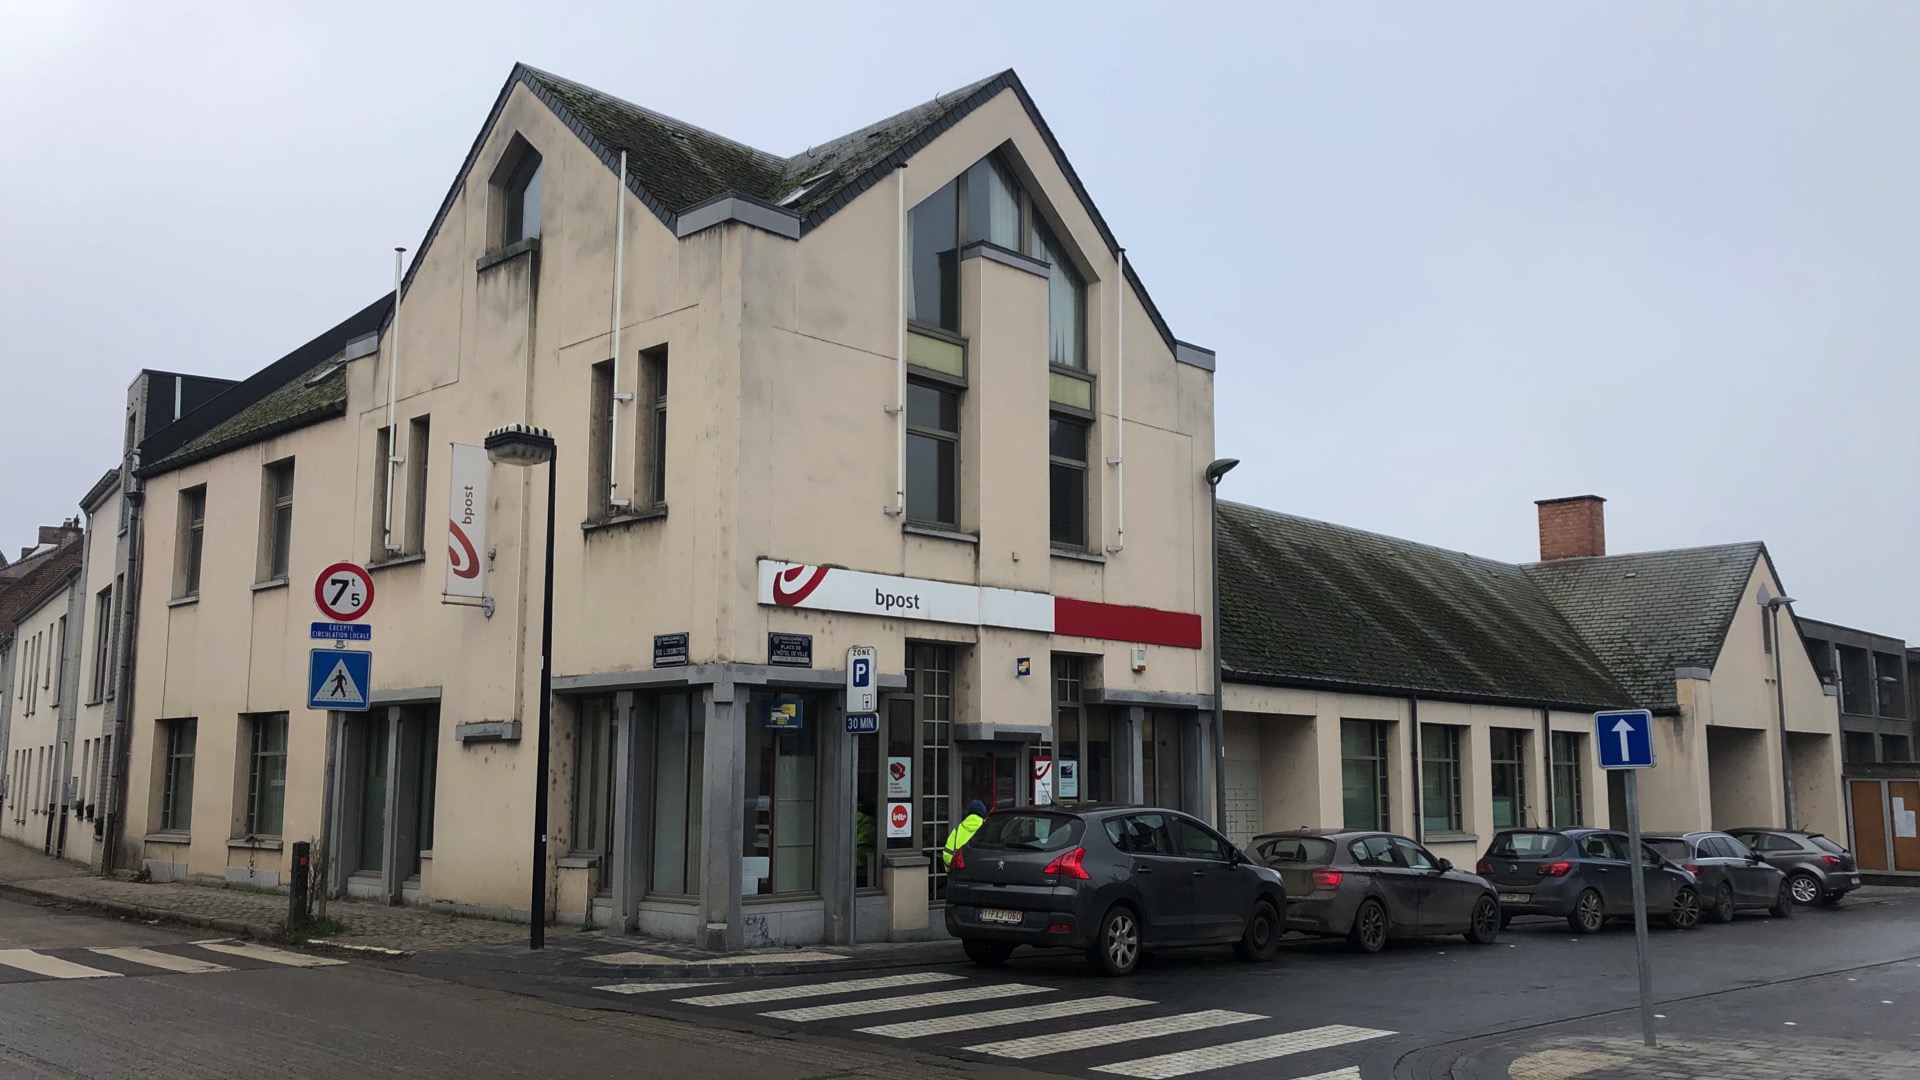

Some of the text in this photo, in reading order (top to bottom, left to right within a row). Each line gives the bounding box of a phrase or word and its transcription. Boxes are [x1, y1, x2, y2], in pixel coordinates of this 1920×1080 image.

[461, 485, 475, 525] bpost
[330, 578, 360, 606] 7 t 5
[875, 587, 920, 611] bpost
[312, 630, 370, 640] CIRCULATION LOCALE
[655, 648, 663, 656] RUE
[856, 664, 866, 682] P
[847, 717, 859, 730] 30
